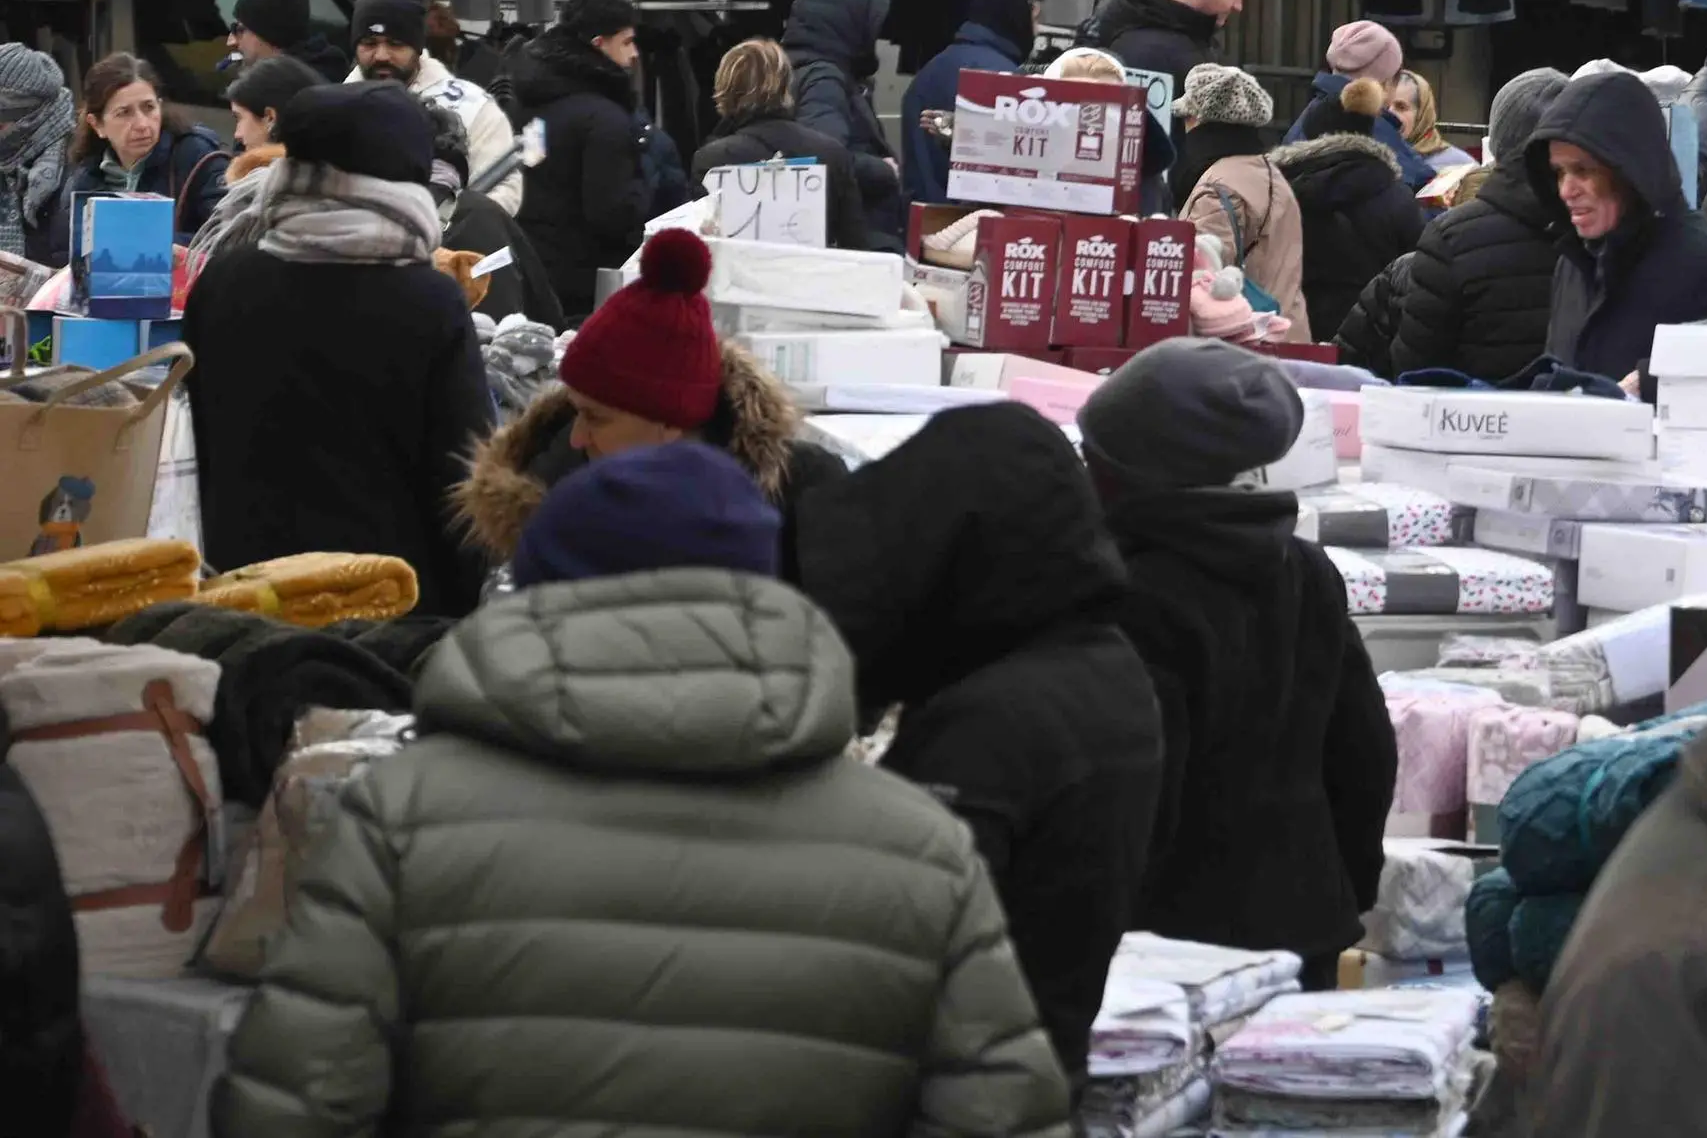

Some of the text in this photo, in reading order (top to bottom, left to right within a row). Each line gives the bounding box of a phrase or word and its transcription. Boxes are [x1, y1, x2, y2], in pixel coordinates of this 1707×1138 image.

[1013, 135, 1048, 157] KIT
[1122, 137, 1140, 164] KIT
[710, 166, 822, 203] TUTTO
[1003, 261, 1045, 272] COMFORT
[1074, 257, 1116, 270] COMFORT
[1146, 258, 1183, 270] COMFORT
[1001, 271, 1045, 298] KIT
[1071, 269, 1115, 297] KIT
[1143, 270, 1183, 297] KIT
